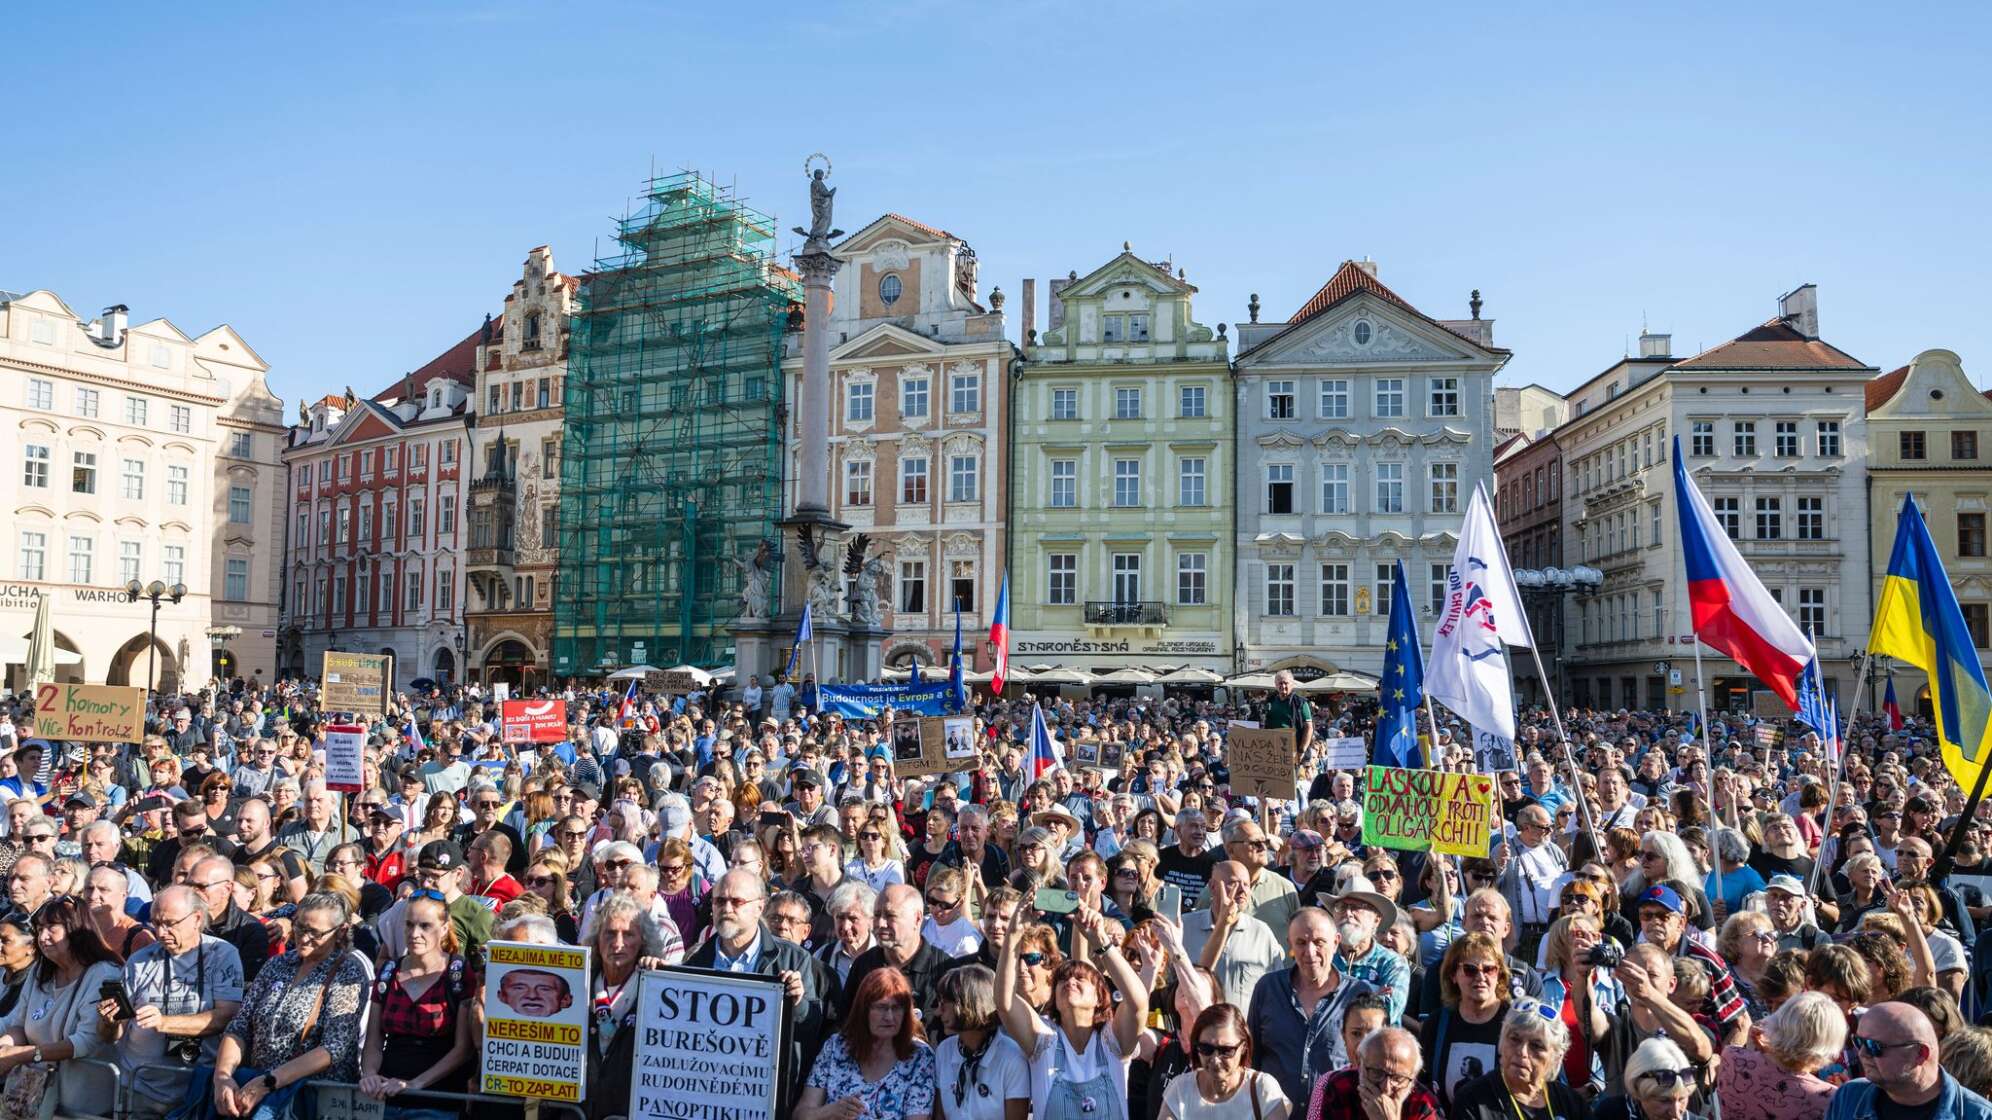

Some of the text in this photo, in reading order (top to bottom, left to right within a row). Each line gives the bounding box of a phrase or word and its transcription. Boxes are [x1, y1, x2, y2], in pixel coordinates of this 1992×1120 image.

[0, 599, 37, 608] ibitio
[75, 590, 129, 603] WARHO
[1438, 592, 1462, 637] CHVILEK
[38, 684, 131, 716] 2 Komory
[821, 693, 883, 704] Budoucnost
[886, 694, 896, 704] je
[899, 692, 934, 703] Evropa
[1452, 774, 1472, 802] A
[1375, 814, 1480, 845] OLIGARCHII
[490, 948, 545, 964] NEZAJÍMÁ
[567, 954, 583, 967] TO
[658, 987, 767, 1028] STOP
[487, 1019, 580, 1043] NEŘEŠÍM TO
[645, 1028, 769, 1058] BUREŠOVĚ
[487, 1041, 580, 1062] CHCI A BUDU!!
[486, 1056, 579, 1080] ČERPAT DOTACE
[642, 1054, 769, 1079] ZADLUŽOVACÍMU
[527, 1081, 578, 1098] ZAPLATÍ
[641, 1072, 769, 1098] RUDOHNĚDÉMU
